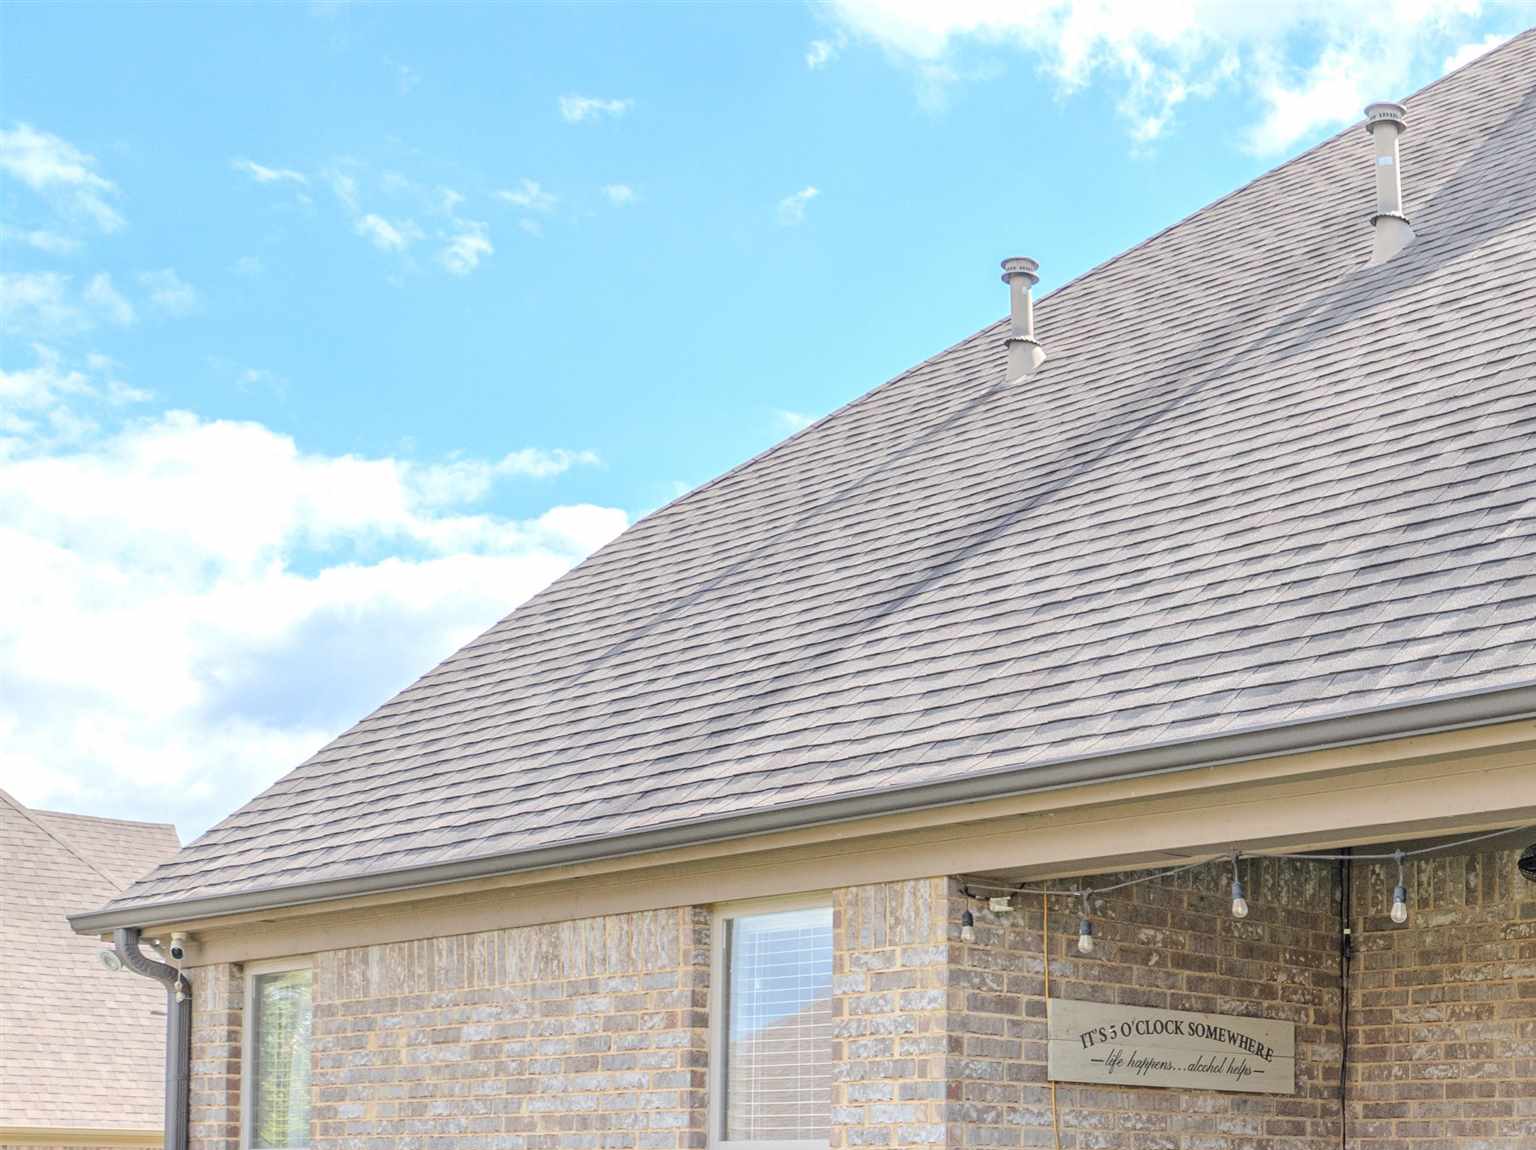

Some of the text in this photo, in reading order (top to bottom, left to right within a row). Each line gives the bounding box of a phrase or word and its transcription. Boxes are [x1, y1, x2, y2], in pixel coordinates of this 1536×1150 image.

[1080, 1019, 1275, 1063] IT'S 5 O'CLOCK SOMEWHERE
